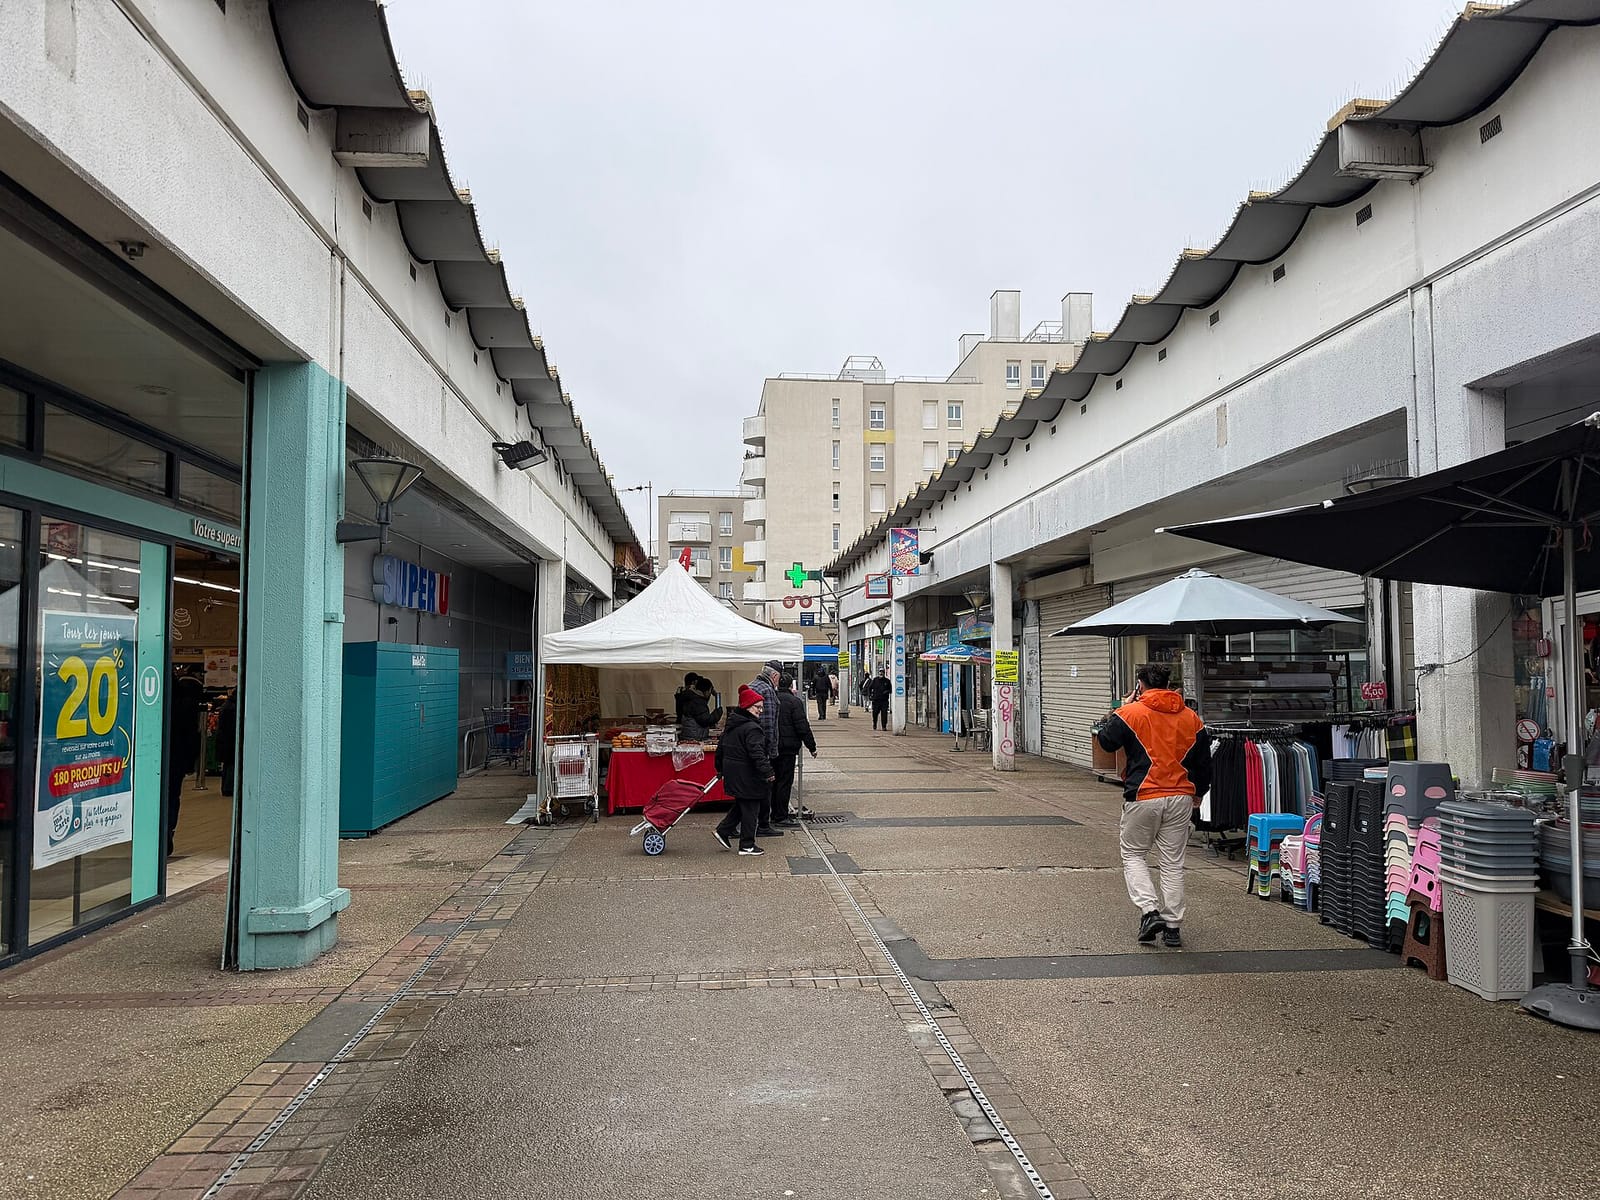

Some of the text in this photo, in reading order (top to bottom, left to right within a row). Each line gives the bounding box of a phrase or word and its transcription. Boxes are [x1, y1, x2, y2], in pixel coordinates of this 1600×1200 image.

[194, 519, 215, 540] Votre
[892, 545, 918, 558] CHICKEN
[377, 554, 450, 616] SUPER U
[61, 622, 121, 645] Tous les jours
[145, 676, 155, 696] U
[54, 761, 121, 786] 180 PRODUITS U
